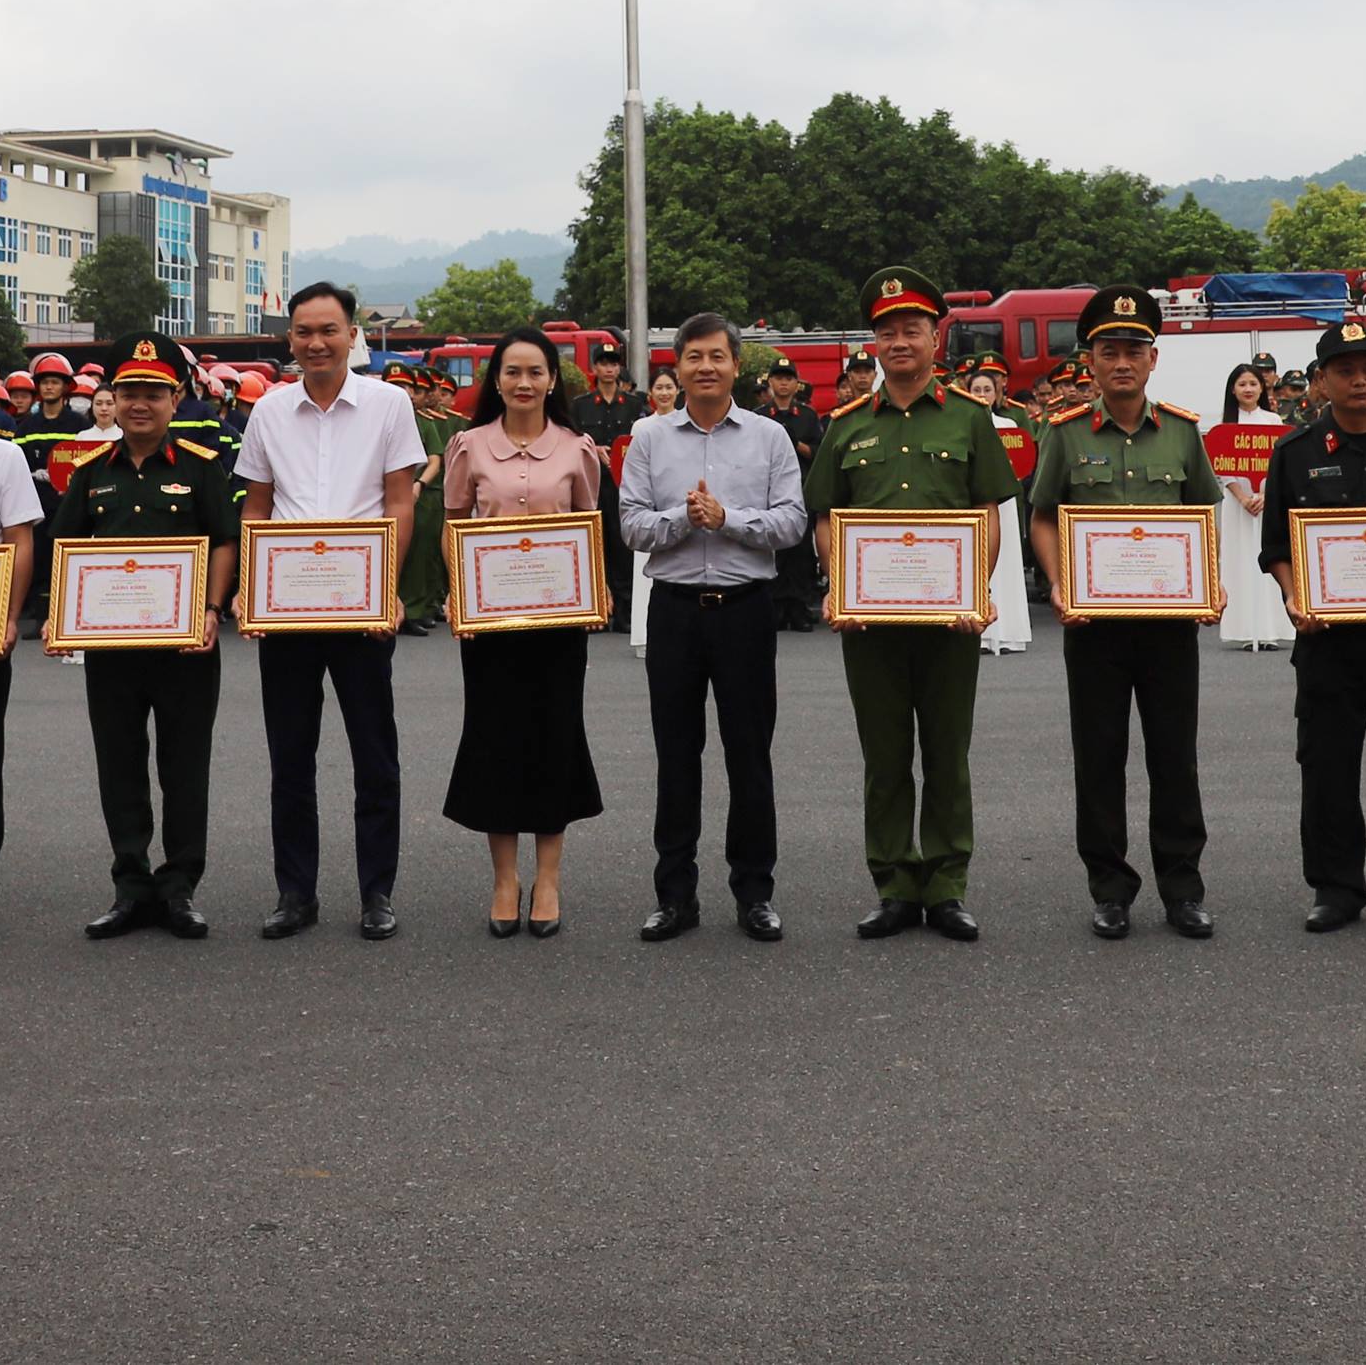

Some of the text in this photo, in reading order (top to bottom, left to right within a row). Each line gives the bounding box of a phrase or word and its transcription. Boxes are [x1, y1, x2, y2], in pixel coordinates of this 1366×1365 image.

[0, 177, 8, 202] B
[1235, 432, 1250, 449] CÁC
[1252, 434, 1269, 449] ĐƠN
[1214, 453, 1269, 472] CÔNG AN TỈNH
